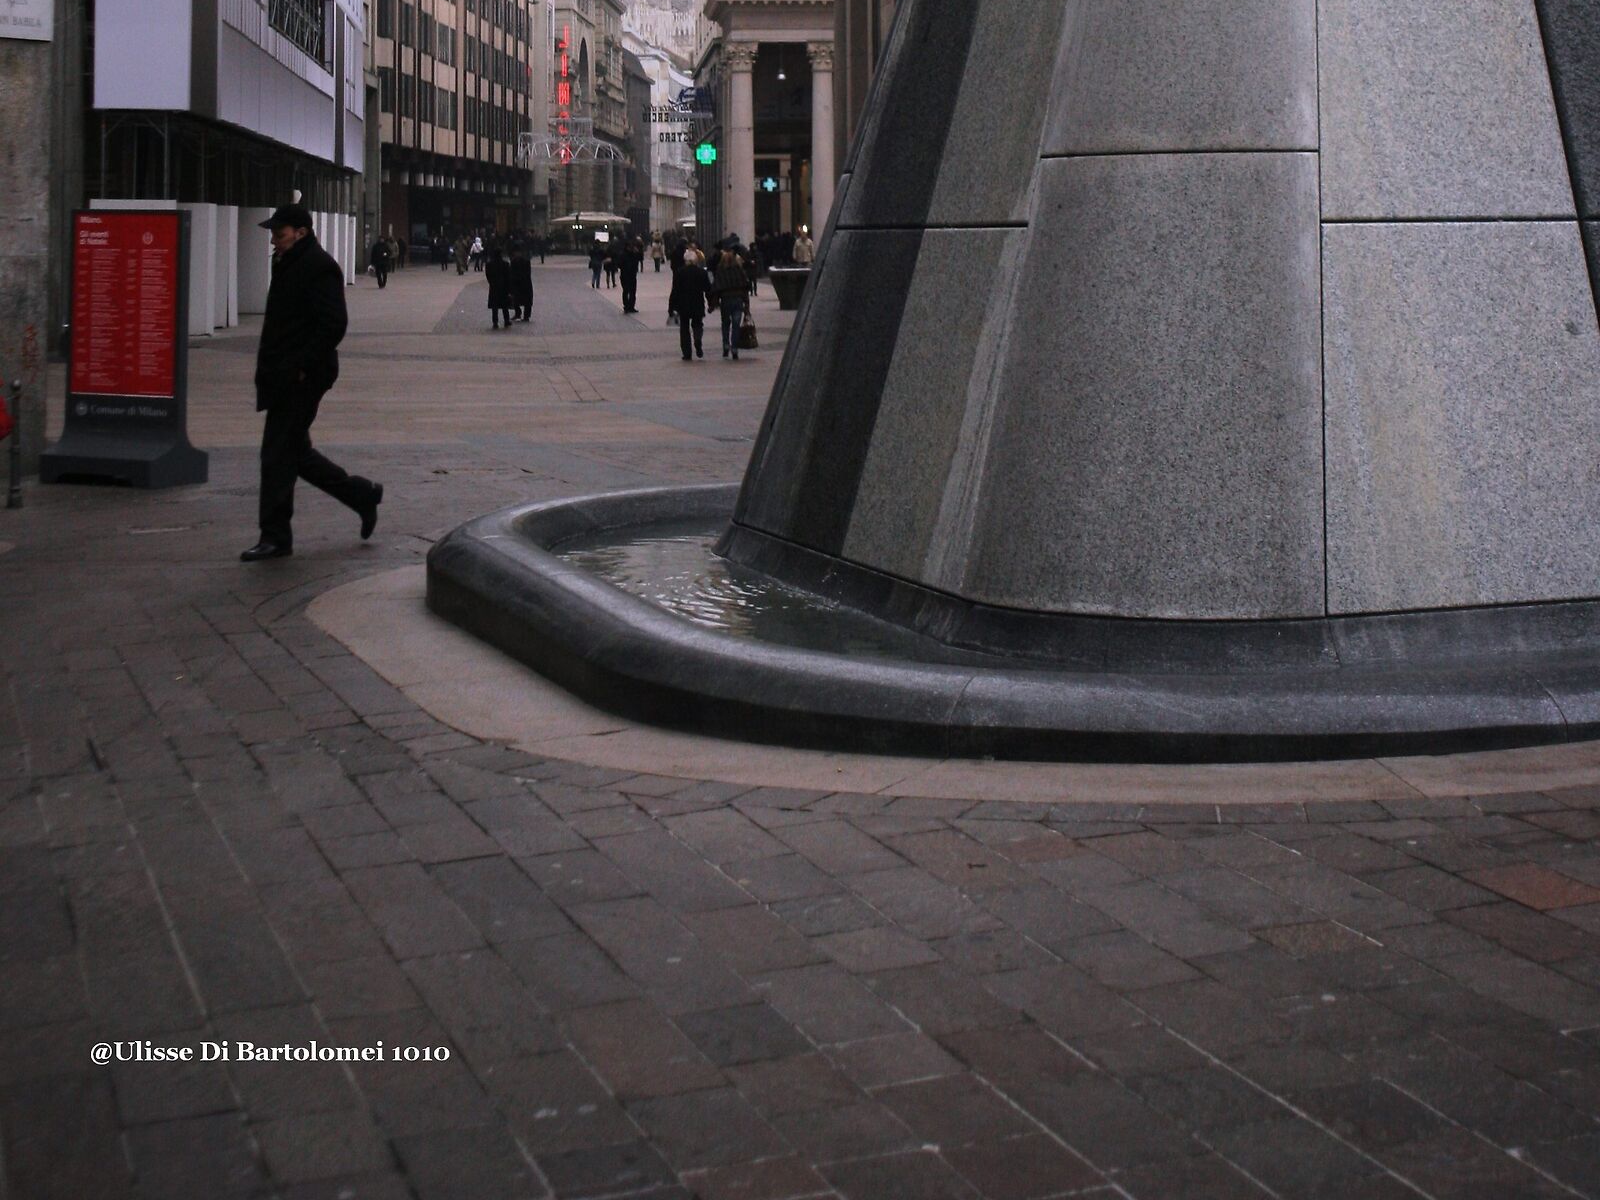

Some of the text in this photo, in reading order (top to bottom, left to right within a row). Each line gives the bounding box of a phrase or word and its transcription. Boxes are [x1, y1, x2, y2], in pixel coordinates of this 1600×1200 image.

[90, 404, 168, 417] Comune di Milano
